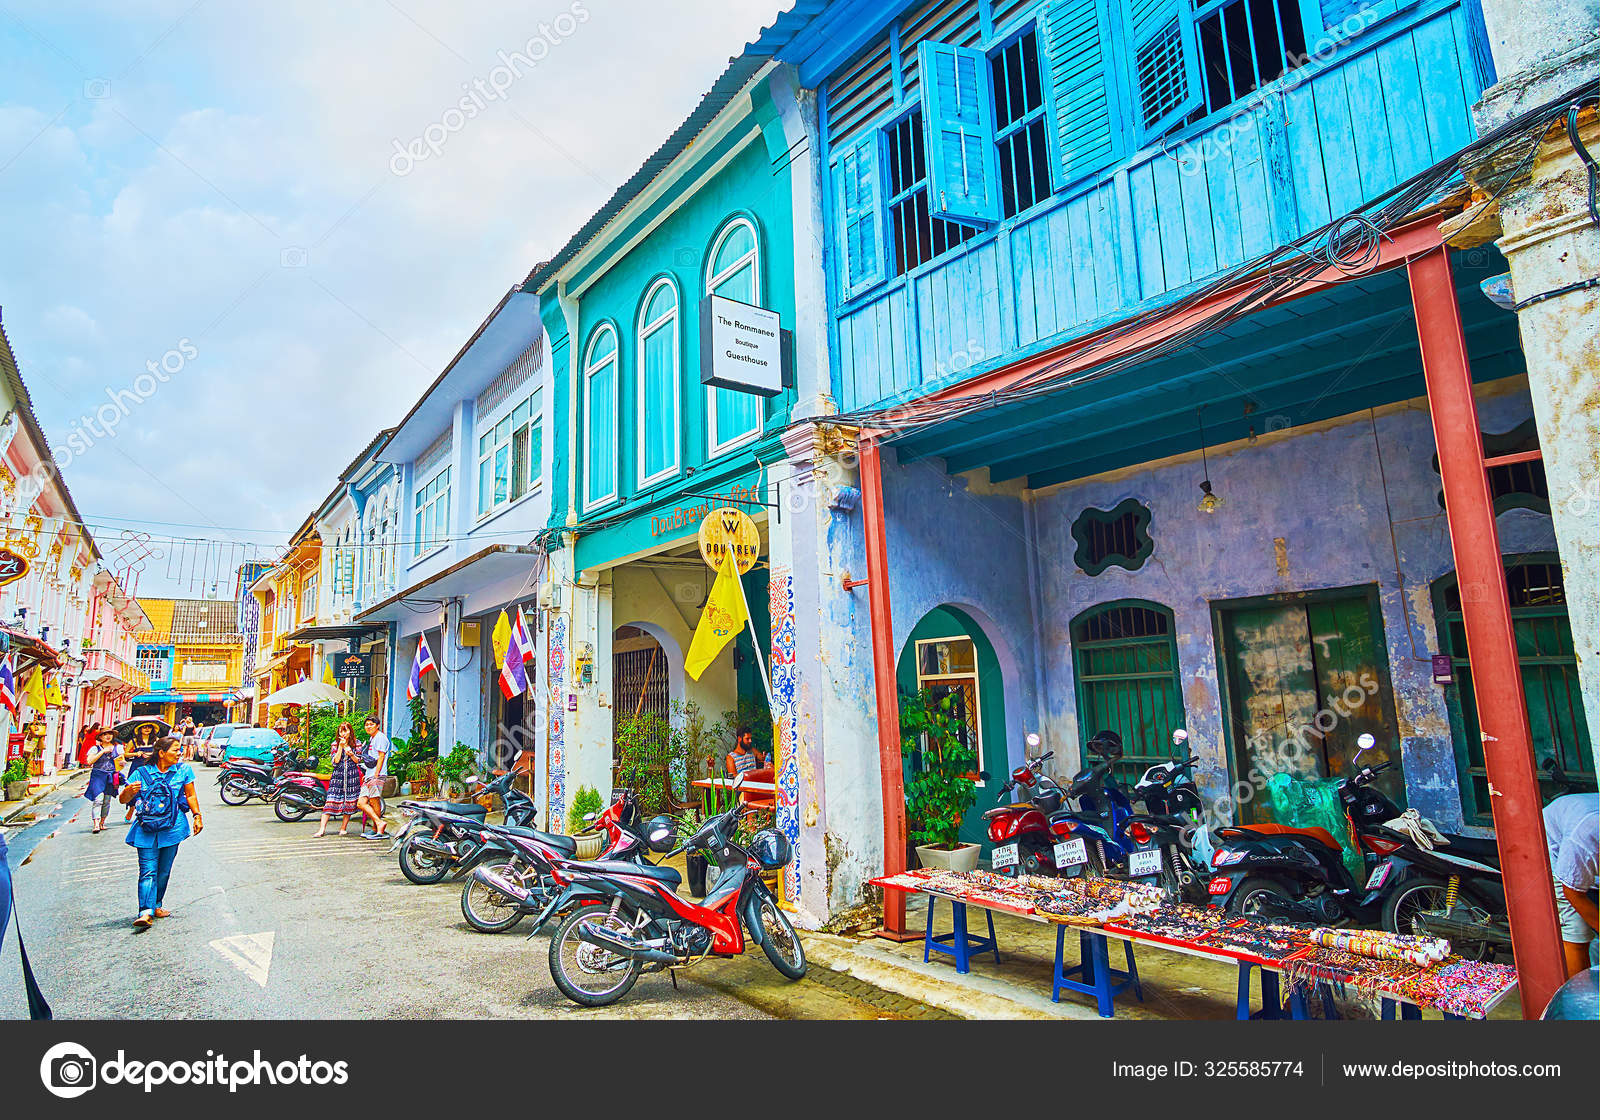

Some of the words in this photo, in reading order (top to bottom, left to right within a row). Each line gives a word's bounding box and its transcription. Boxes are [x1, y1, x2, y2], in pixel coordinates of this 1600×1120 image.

[717, 315, 732, 327] The
[734, 320, 775, 338] Rommanee
[735, 338, 759, 350] Boutique
[725, 350, 768, 367] Guesthouse
[651, 503, 708, 537] DouBrew
